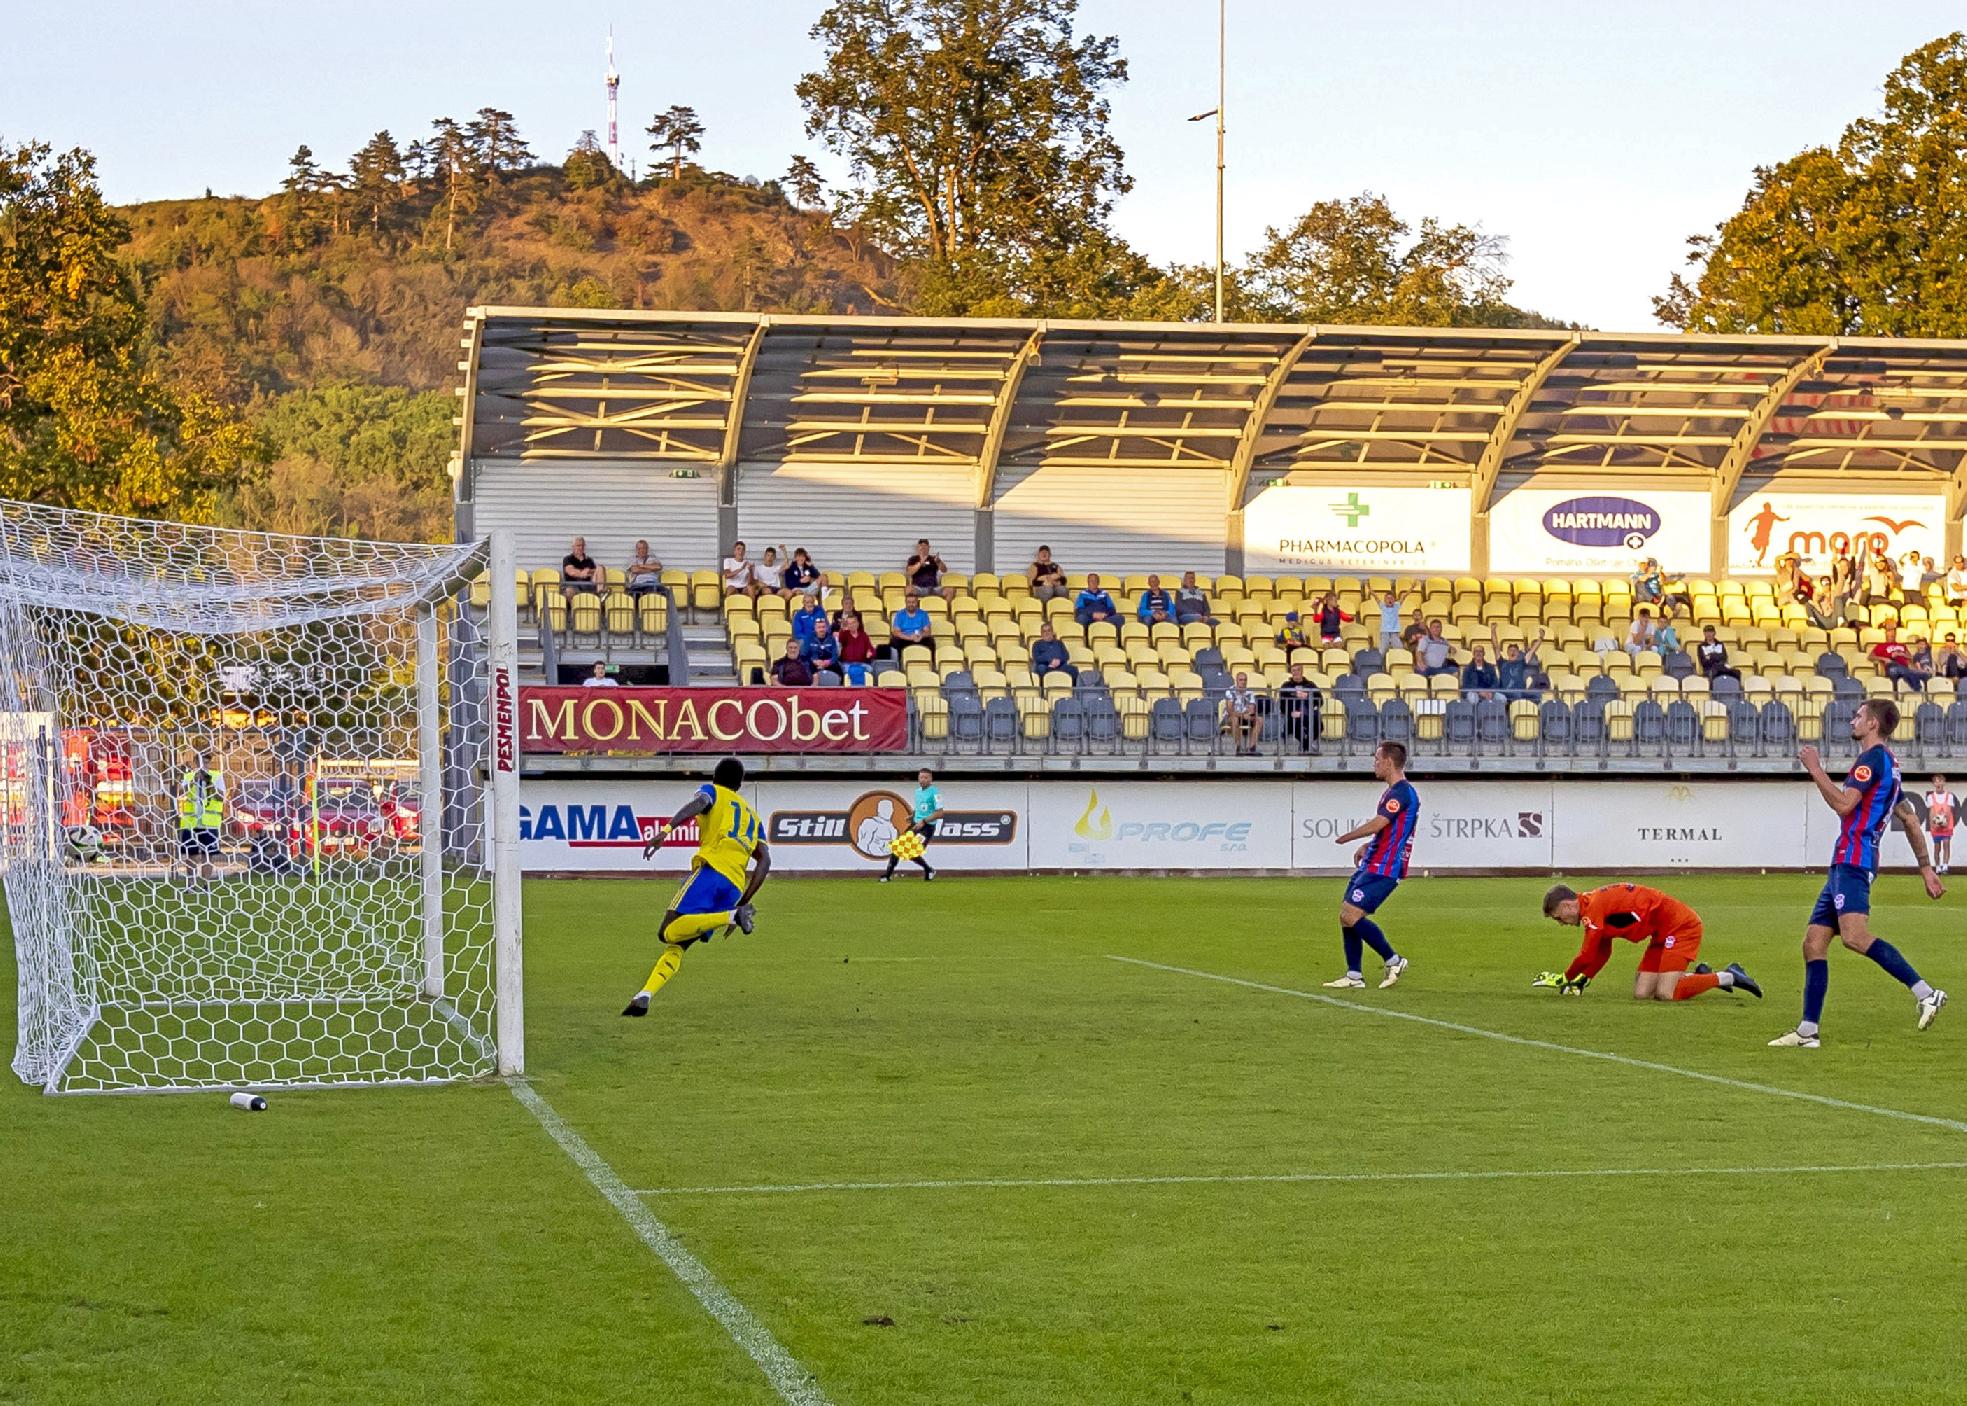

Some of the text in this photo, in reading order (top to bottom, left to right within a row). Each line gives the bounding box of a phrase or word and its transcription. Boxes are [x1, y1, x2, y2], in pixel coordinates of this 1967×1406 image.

[1552, 513, 1651, 530] HARTMANN
[1279, 539, 1425, 554] PHARMACOPOLA
[496, 667, 512, 772] PESMENPOL
[526, 697, 869, 741] MONACObet
[778, 816, 1001, 837] Still lass
[1117, 822, 1252, 841] PROFE
[1430, 813, 1513, 839] ŠTRPKA
[1637, 828, 1723, 841] TERMAL
